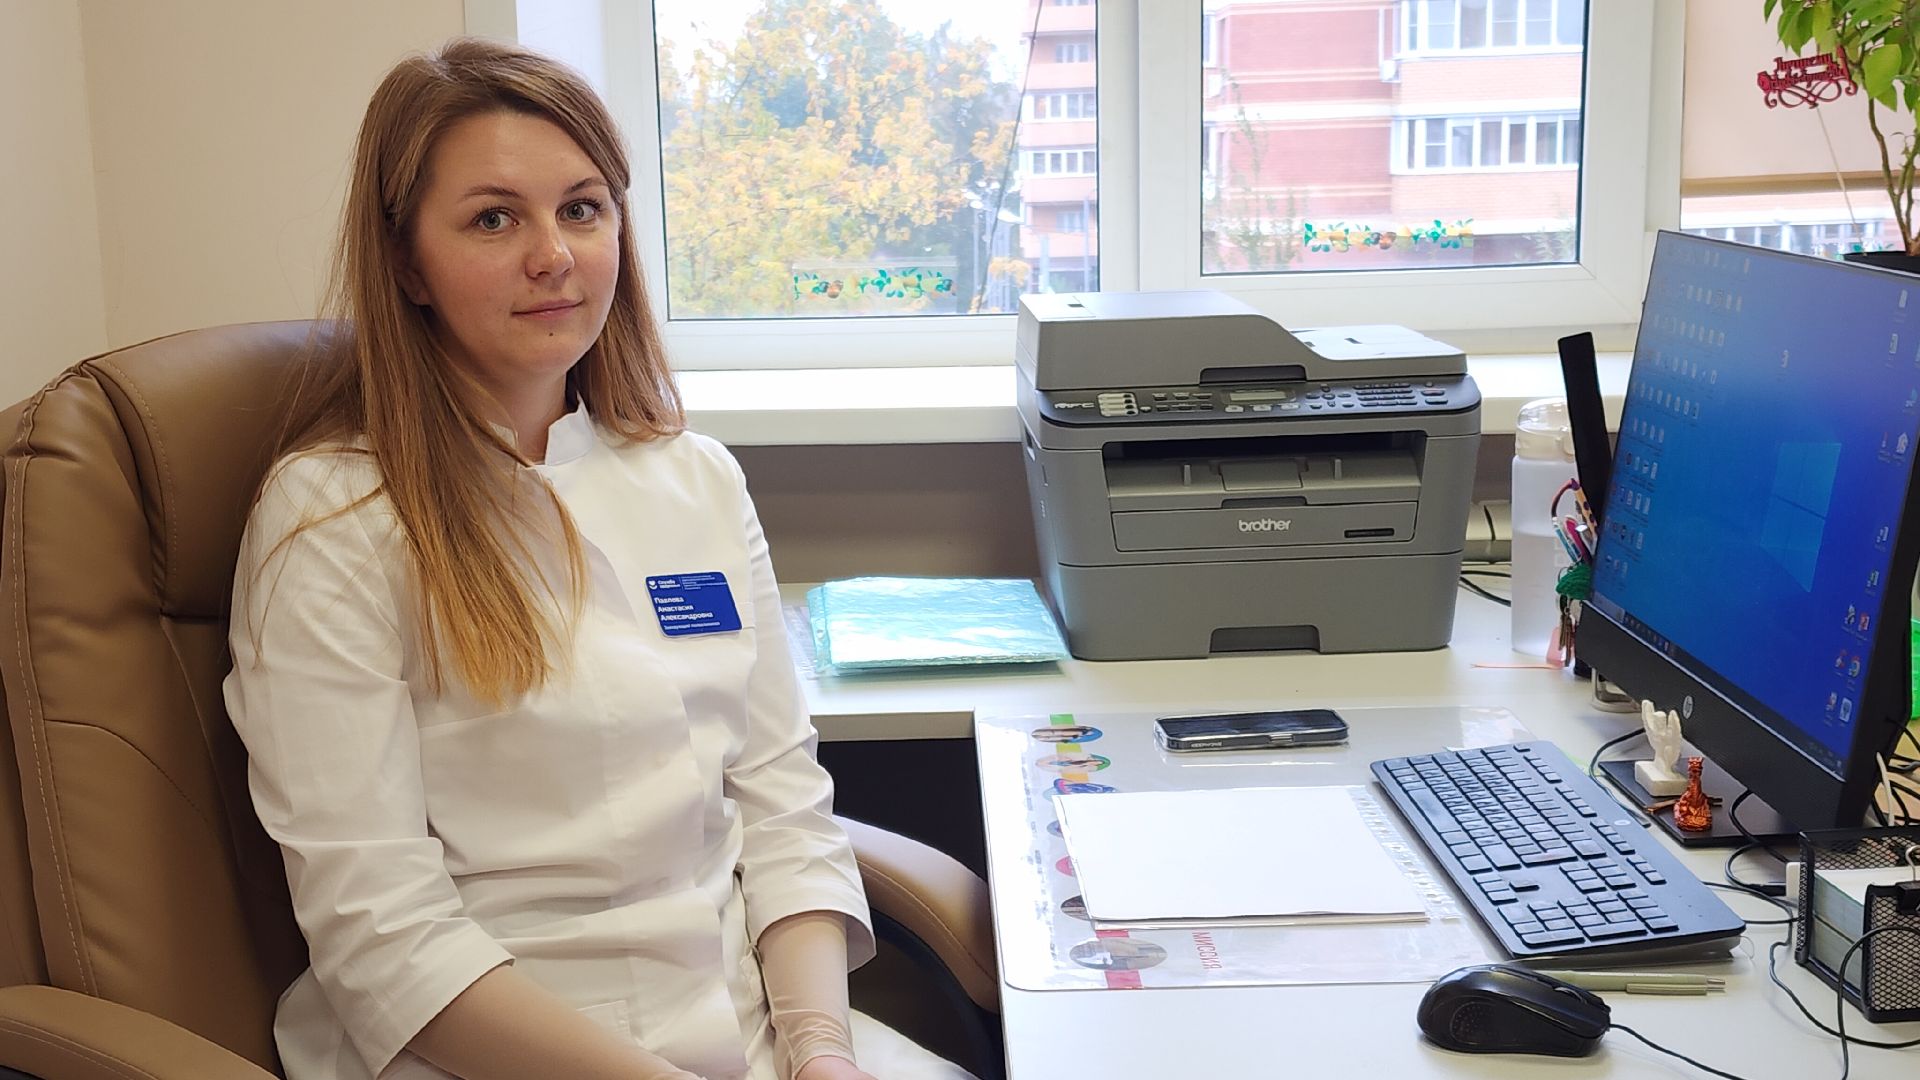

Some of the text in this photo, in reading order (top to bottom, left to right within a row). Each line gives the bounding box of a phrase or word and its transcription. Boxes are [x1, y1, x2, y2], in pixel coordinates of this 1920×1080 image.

[1238, 518, 1292, 531] brother
[660, 612, 714, 621] Александровна
[1192, 932, 1222, 969] МИССИЯ
